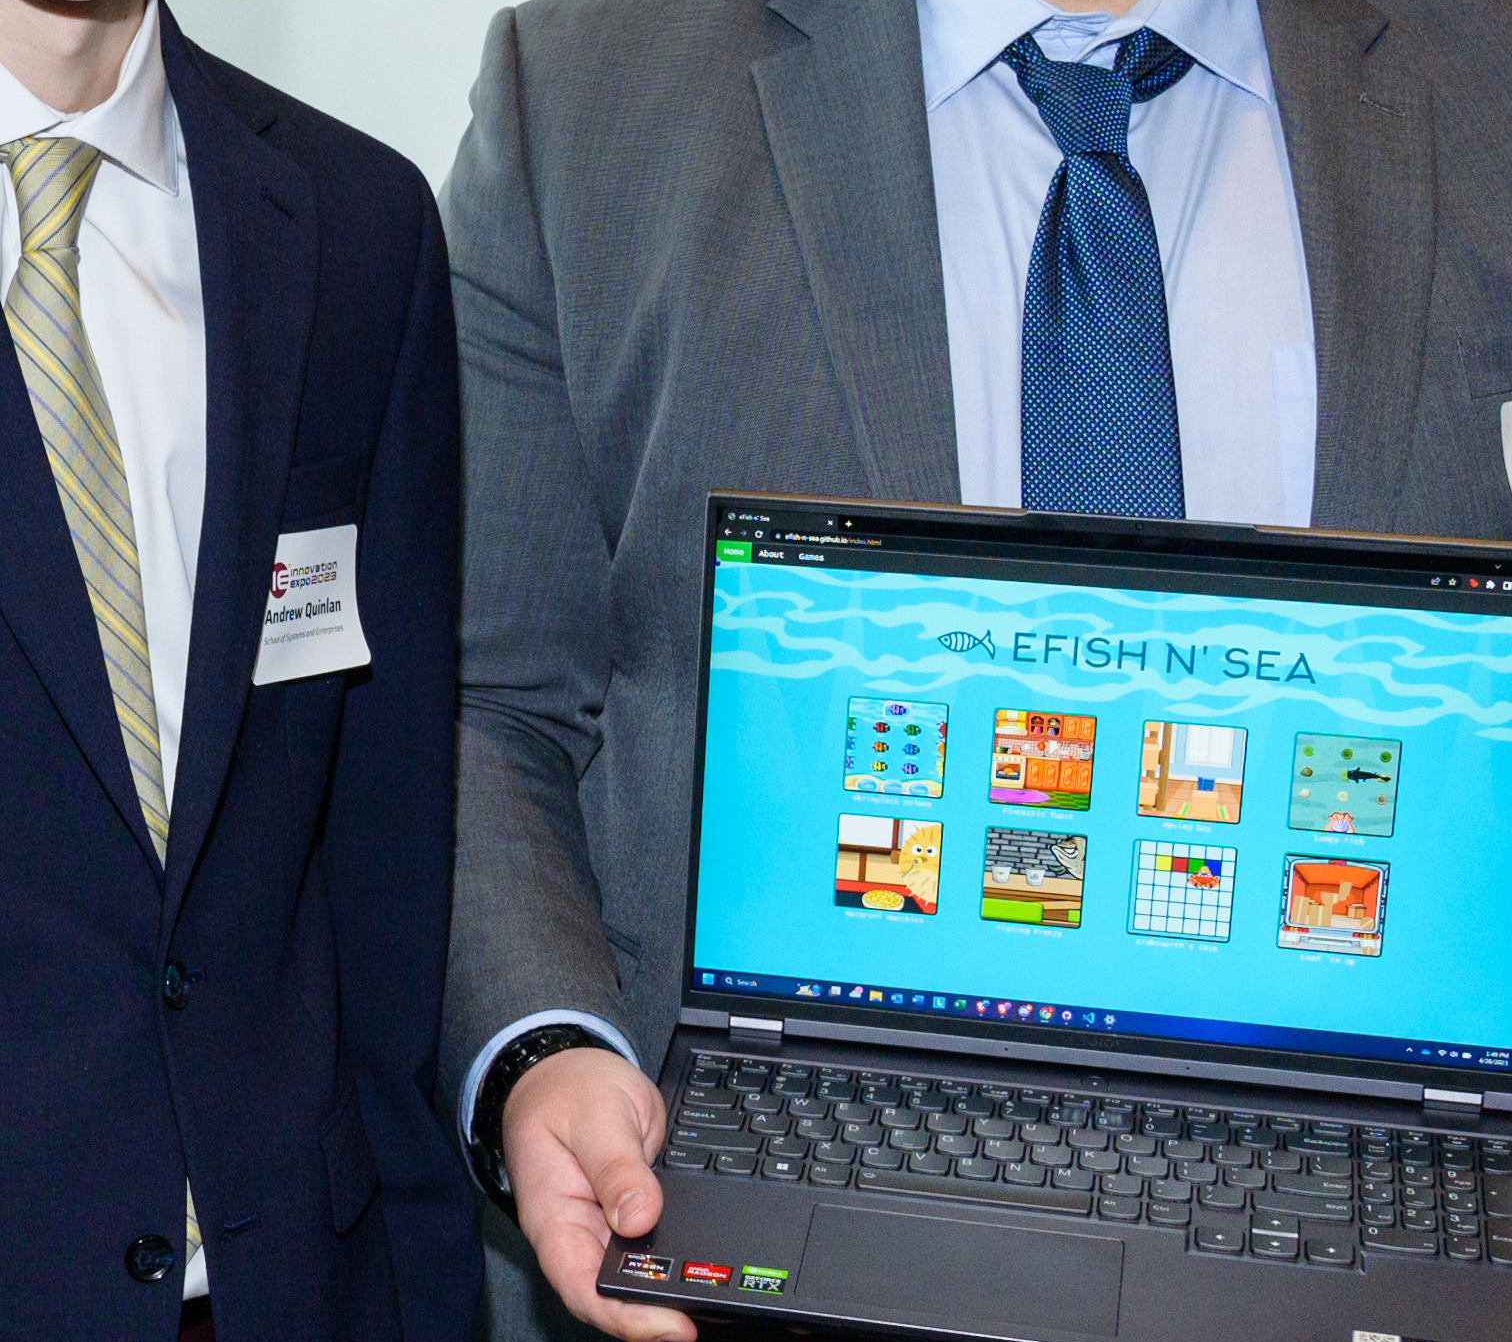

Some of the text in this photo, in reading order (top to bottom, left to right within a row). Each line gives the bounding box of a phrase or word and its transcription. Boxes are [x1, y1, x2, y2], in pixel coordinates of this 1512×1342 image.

[723, 548, 825, 562] Home About Games
[264, 597, 341, 626] Andrew Quinlan
[1013, 631, 1318, 686] EFISH N' SEA
[742, 1280, 779, 1291] RTX
